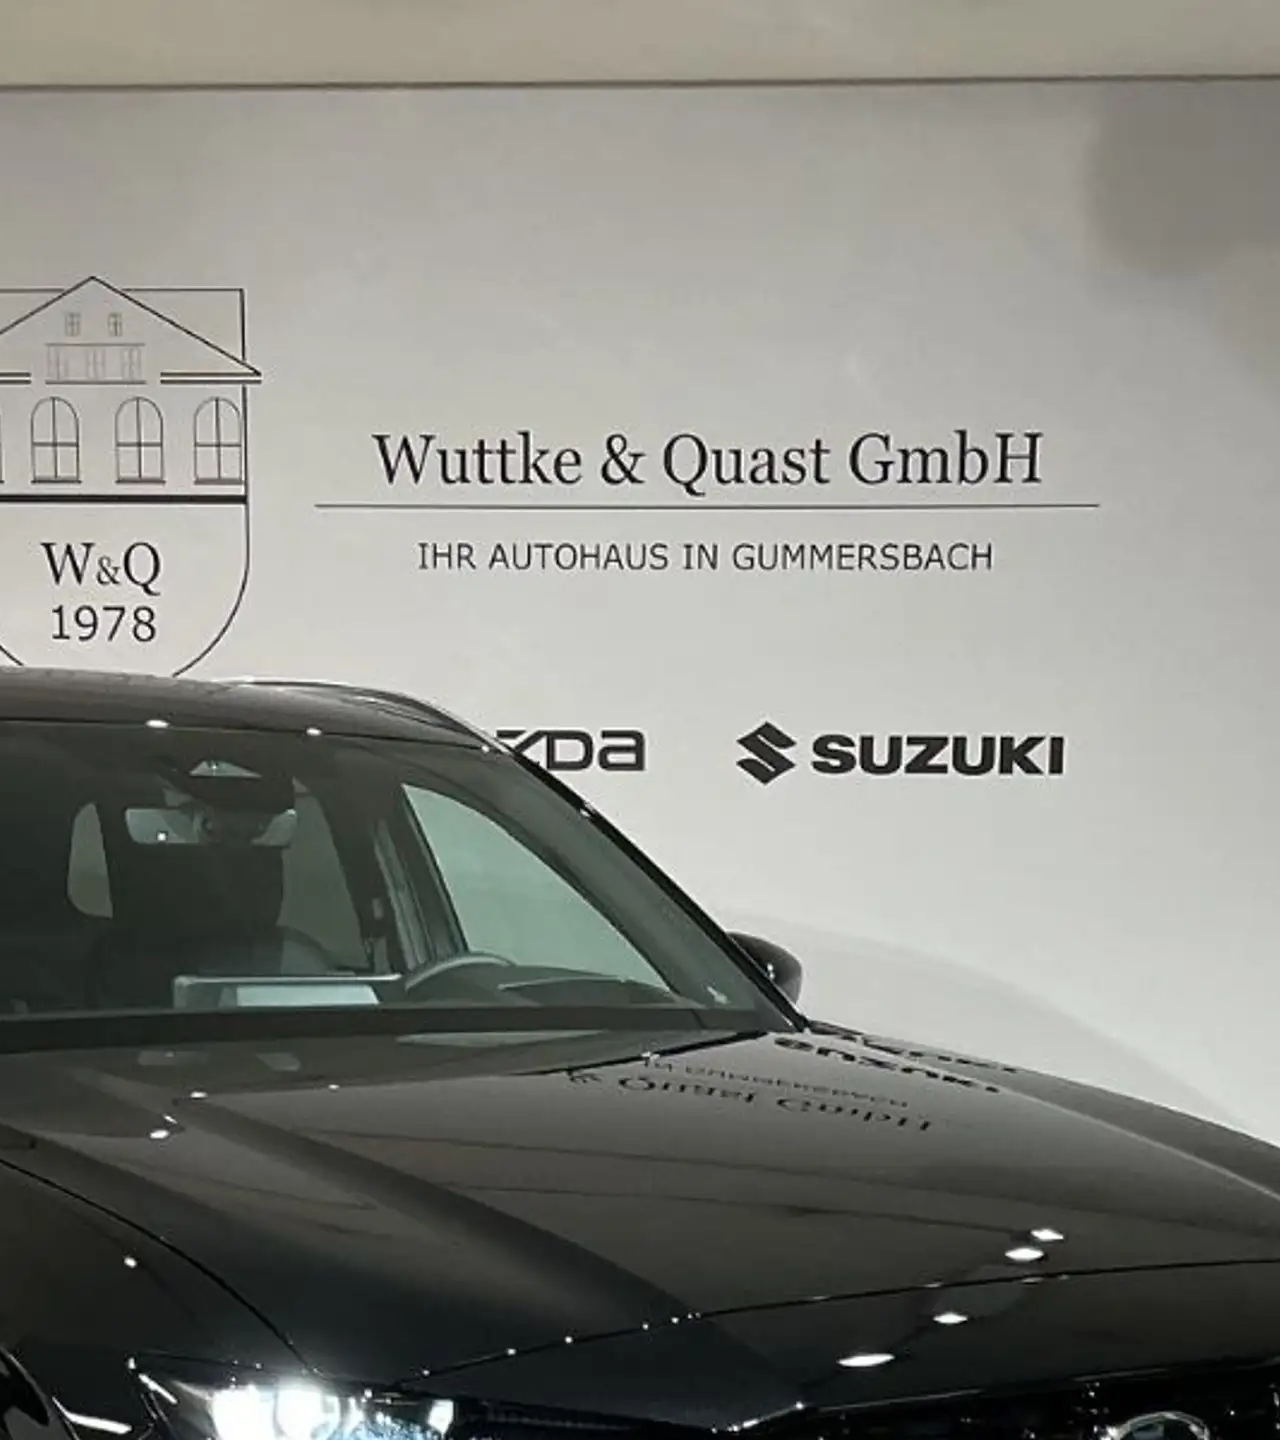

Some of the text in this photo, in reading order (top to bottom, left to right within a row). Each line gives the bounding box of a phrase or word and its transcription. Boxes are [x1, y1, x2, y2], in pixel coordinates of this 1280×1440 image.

[372, 430, 1043, 497] Wuttke & Quast GmbH
[41, 542, 161, 597] W&Q
[418, 542, 993, 571] IHR AUTOHAUS IN GUMMERSBACH
[51, 604, 157, 643] 1978
[811, 734, 1065, 776] SUZUKI
